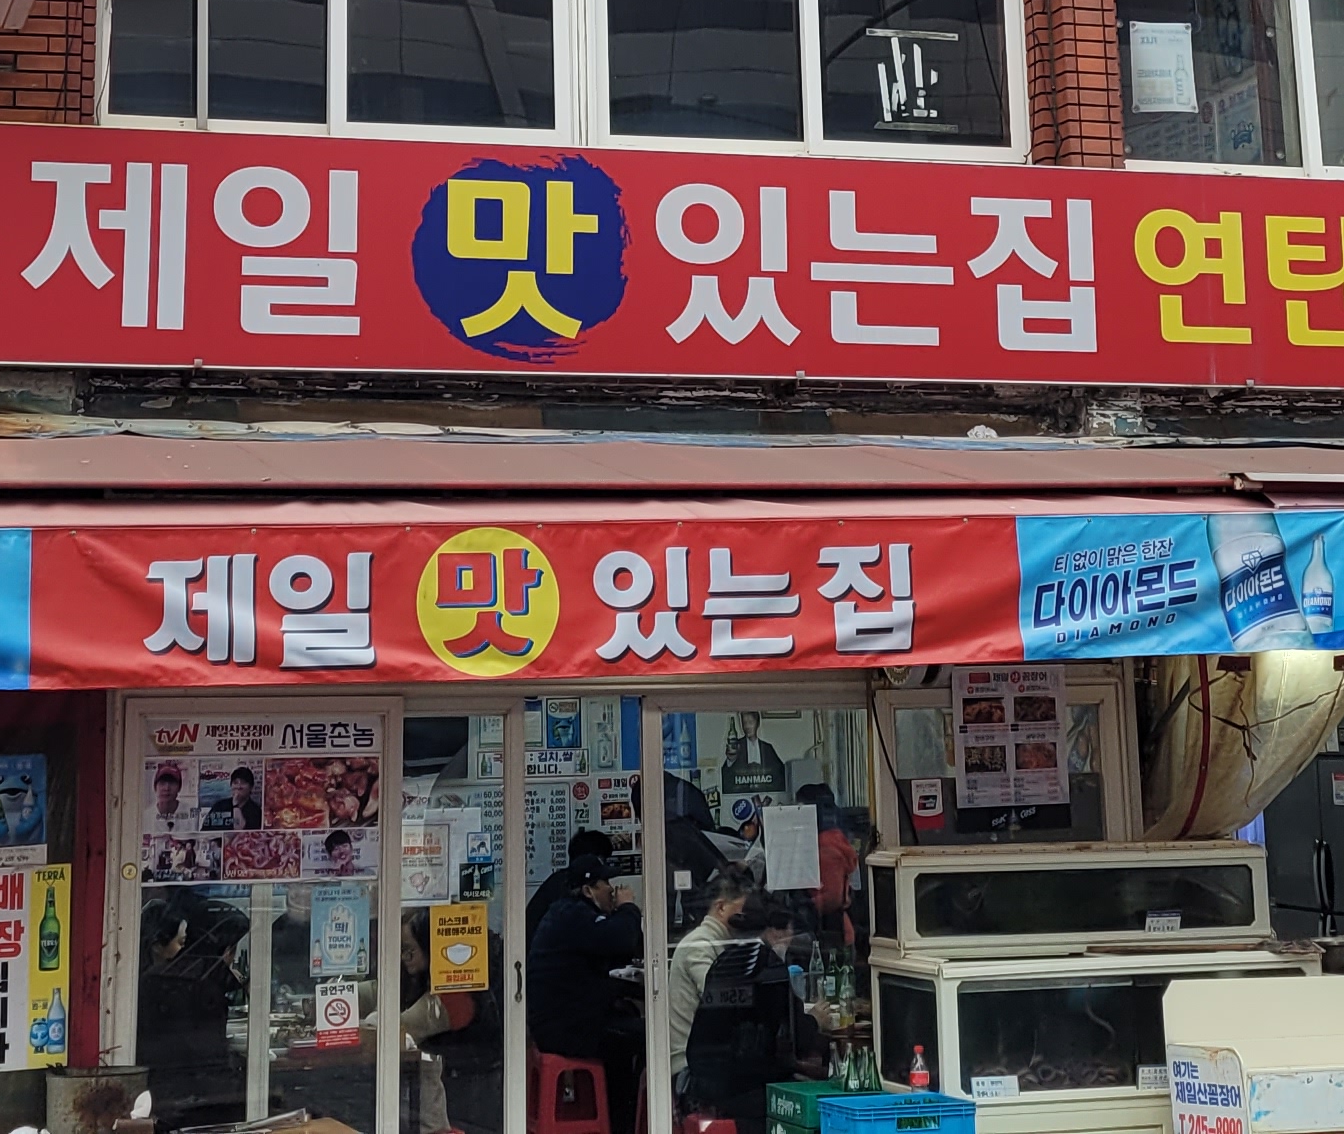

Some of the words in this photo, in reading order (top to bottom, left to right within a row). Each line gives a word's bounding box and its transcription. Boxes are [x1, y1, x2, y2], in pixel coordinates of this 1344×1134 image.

[21, 161, 360, 335] 제일
[1106, 543, 1138, 569] 맑은
[1032, 559, 1199, 630] 다이아몬드
[1224, 567, 1286, 610] 다이아몬드
[143, 553, 376, 668] 제일
[1056, 613, 1177, 644] DIAMOND
[154, 723, 200, 745] tvN
[279, 721, 375, 750] 서울촌놈
[526, 764, 563, 775] 합니다.
[35, 867, 66, 883] TERRA
[319, 983, 355, 996] 금연구역
[1172, 1059, 1199, 1080] 여기는
[1174, 1081, 1243, 1109] 제일산꼼장어
